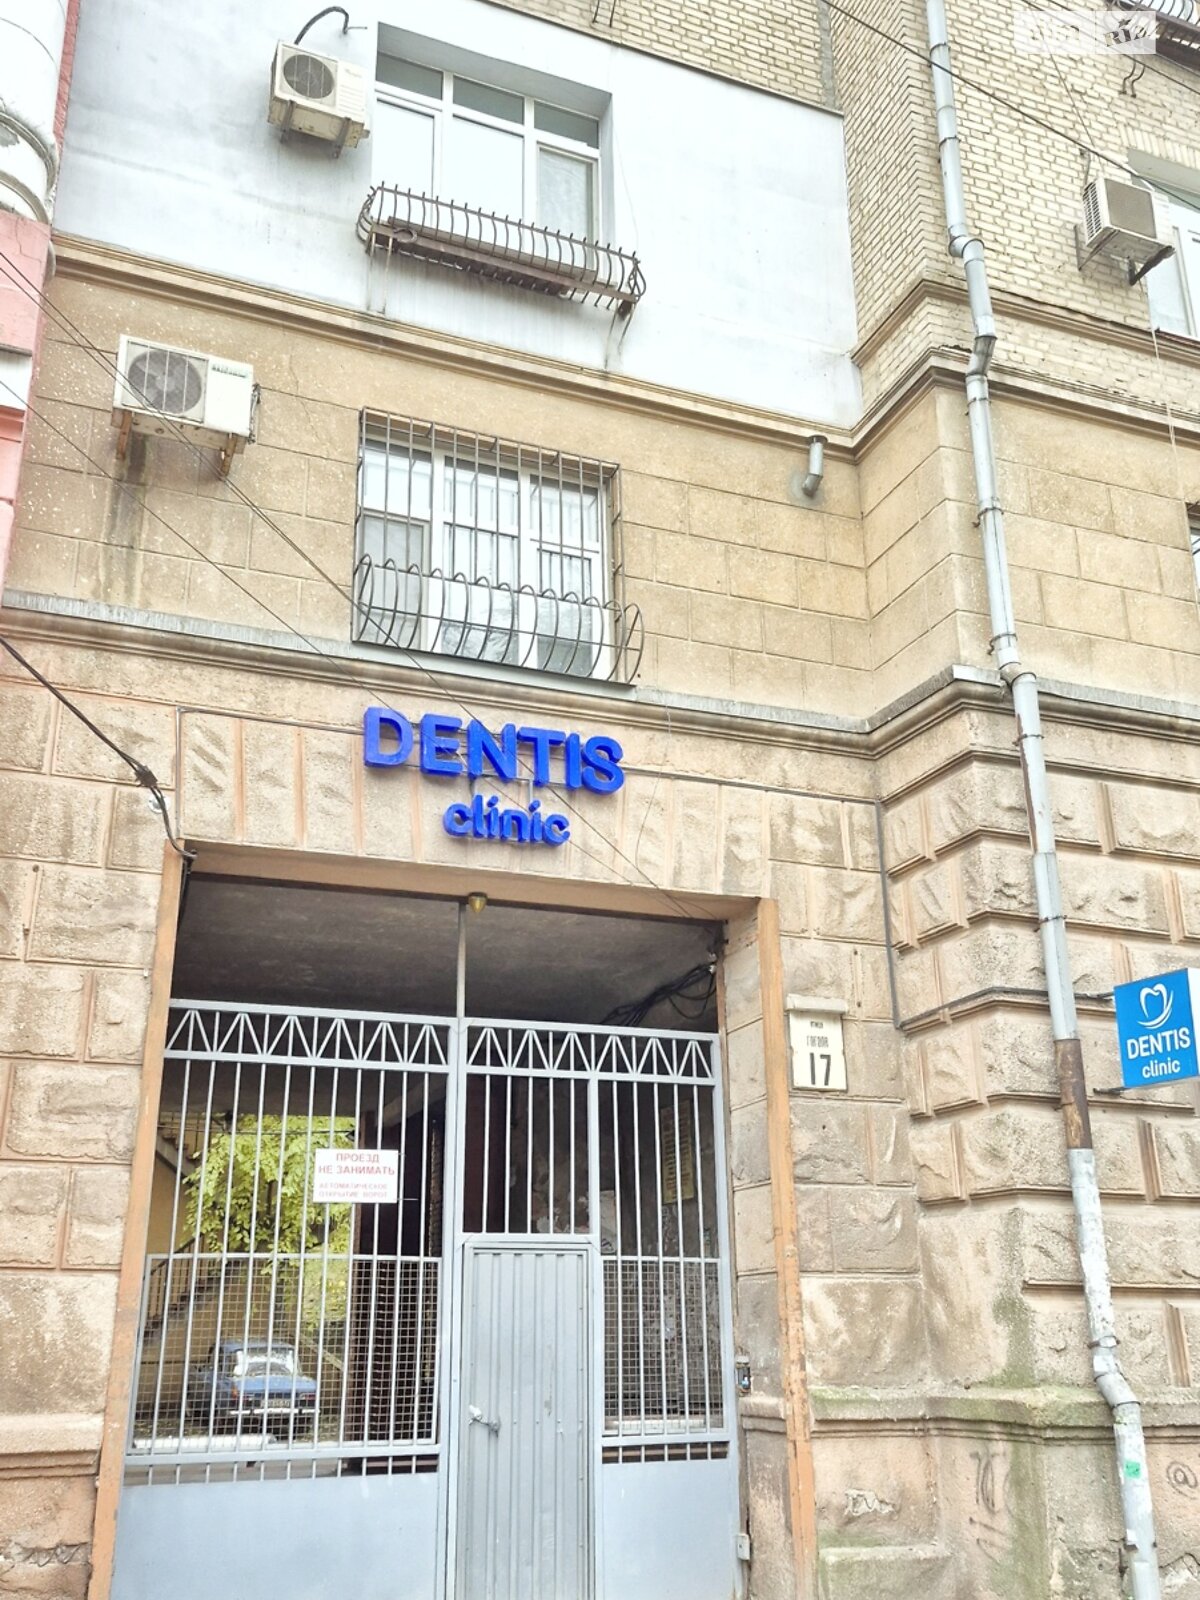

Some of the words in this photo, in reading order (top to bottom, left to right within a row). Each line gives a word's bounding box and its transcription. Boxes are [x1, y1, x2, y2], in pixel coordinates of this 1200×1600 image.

[363, 707, 625, 795] DENTIS
[443, 794, 571, 846] clinic
[1126, 1027, 1191, 1060] DENTIS
[809, 1052, 831, 1086] 17
[1142, 1057, 1181, 1078] clinic
[318, 1165, 333, 1174] НЕ
[336, 1165, 395, 1175] ЗАНИМАТЬ
[336, 1152, 380, 1163] ПРОЕЗД
